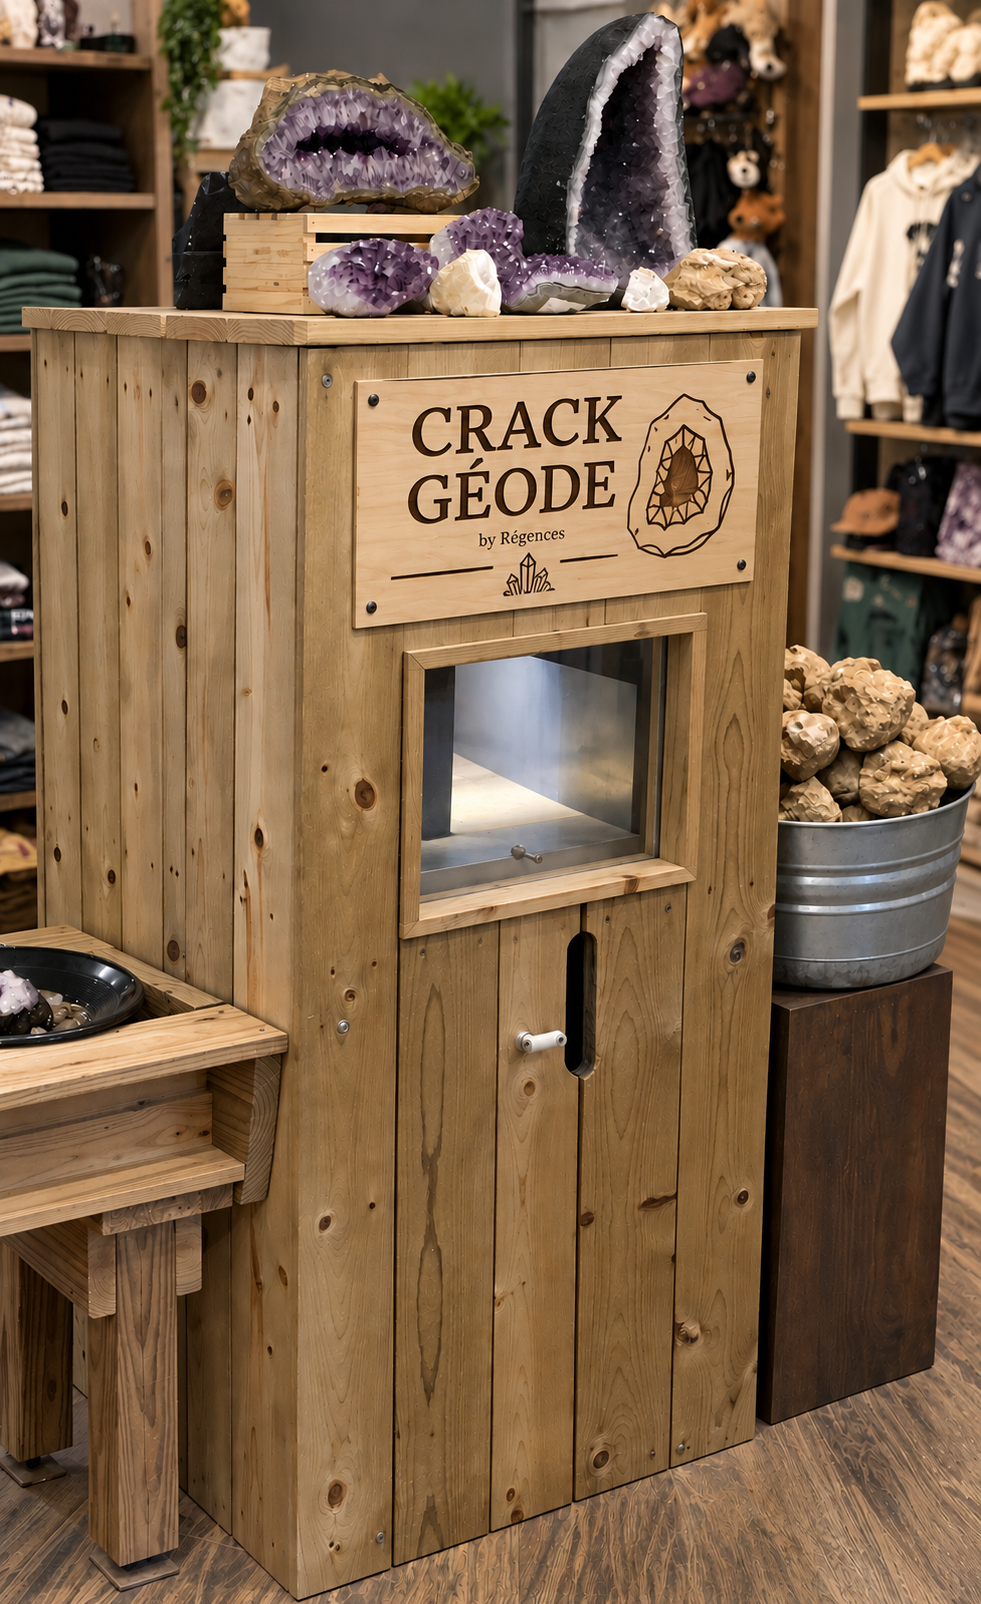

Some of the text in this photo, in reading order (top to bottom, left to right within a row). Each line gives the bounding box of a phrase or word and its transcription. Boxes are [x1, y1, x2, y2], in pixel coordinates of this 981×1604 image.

[412, 395, 623, 458] CRACK
[408, 457, 616, 525] GÉODE
[478, 528, 566, 551] by Régences
